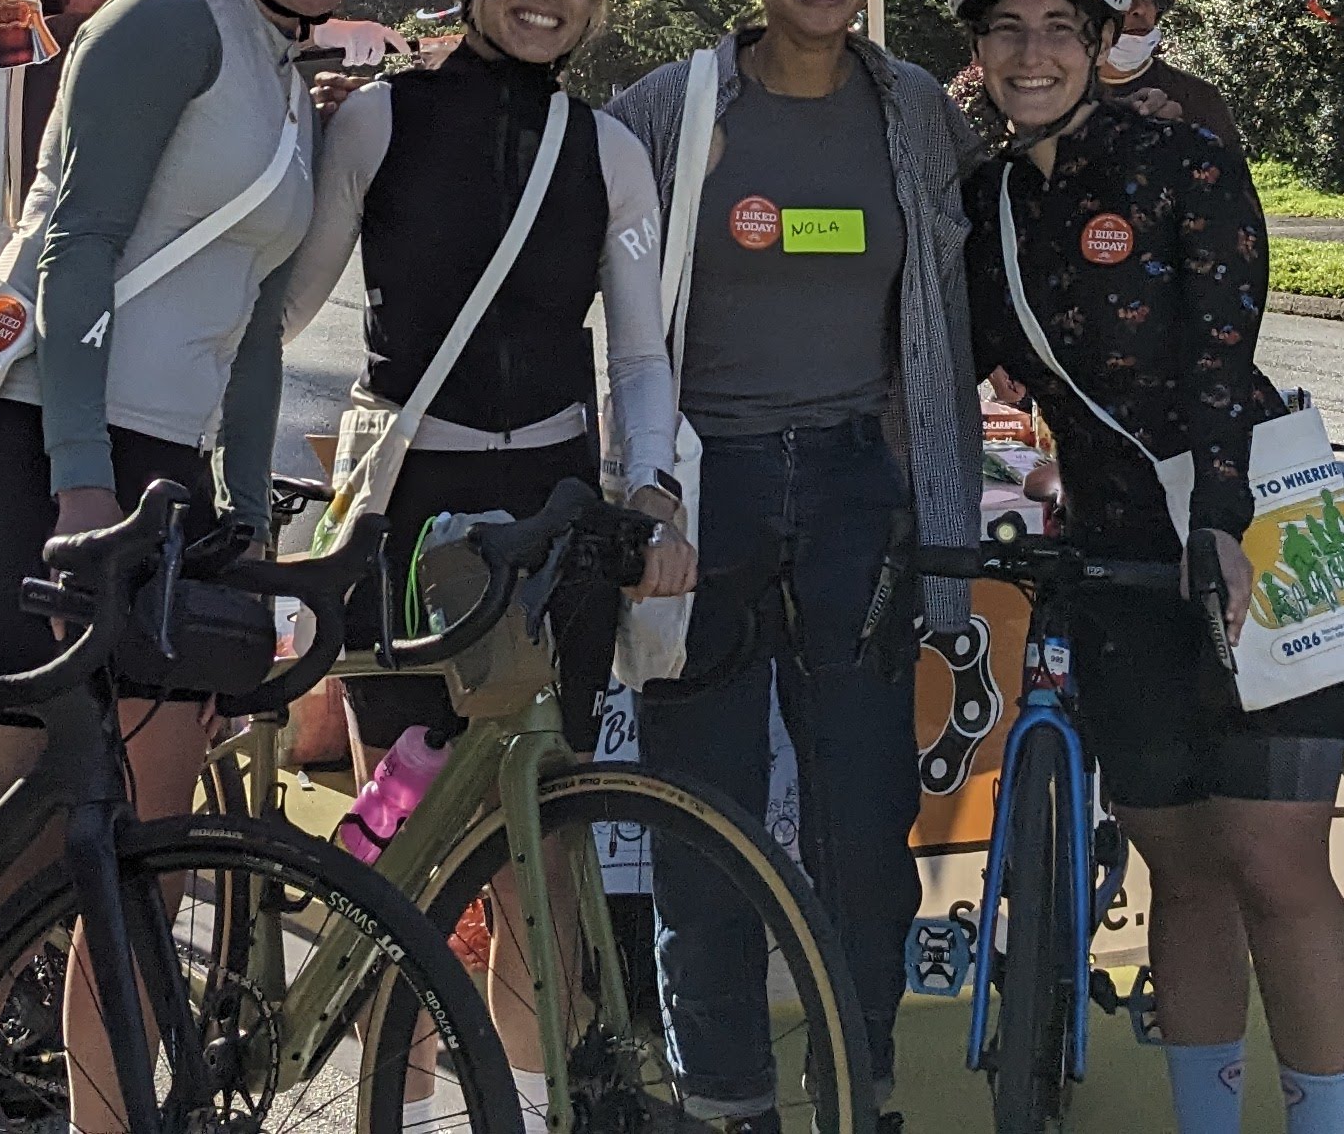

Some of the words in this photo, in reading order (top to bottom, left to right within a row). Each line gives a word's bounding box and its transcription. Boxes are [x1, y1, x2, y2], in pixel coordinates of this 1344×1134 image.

[743, 211, 777, 222] BIKED
[618, 208, 661, 261] RA
[735, 221, 777, 233] TODAY!
[791, 221, 840, 237] NOLA
[1094, 230, 1129, 240] BIKED
[1087, 240, 1127, 252] TODAY!
[1257, 479, 1282, 498] TO
[1282, 631, 1322, 657] 2026
[327, 891, 378, 935] SWISS
[375, 934, 406, 963] DT
